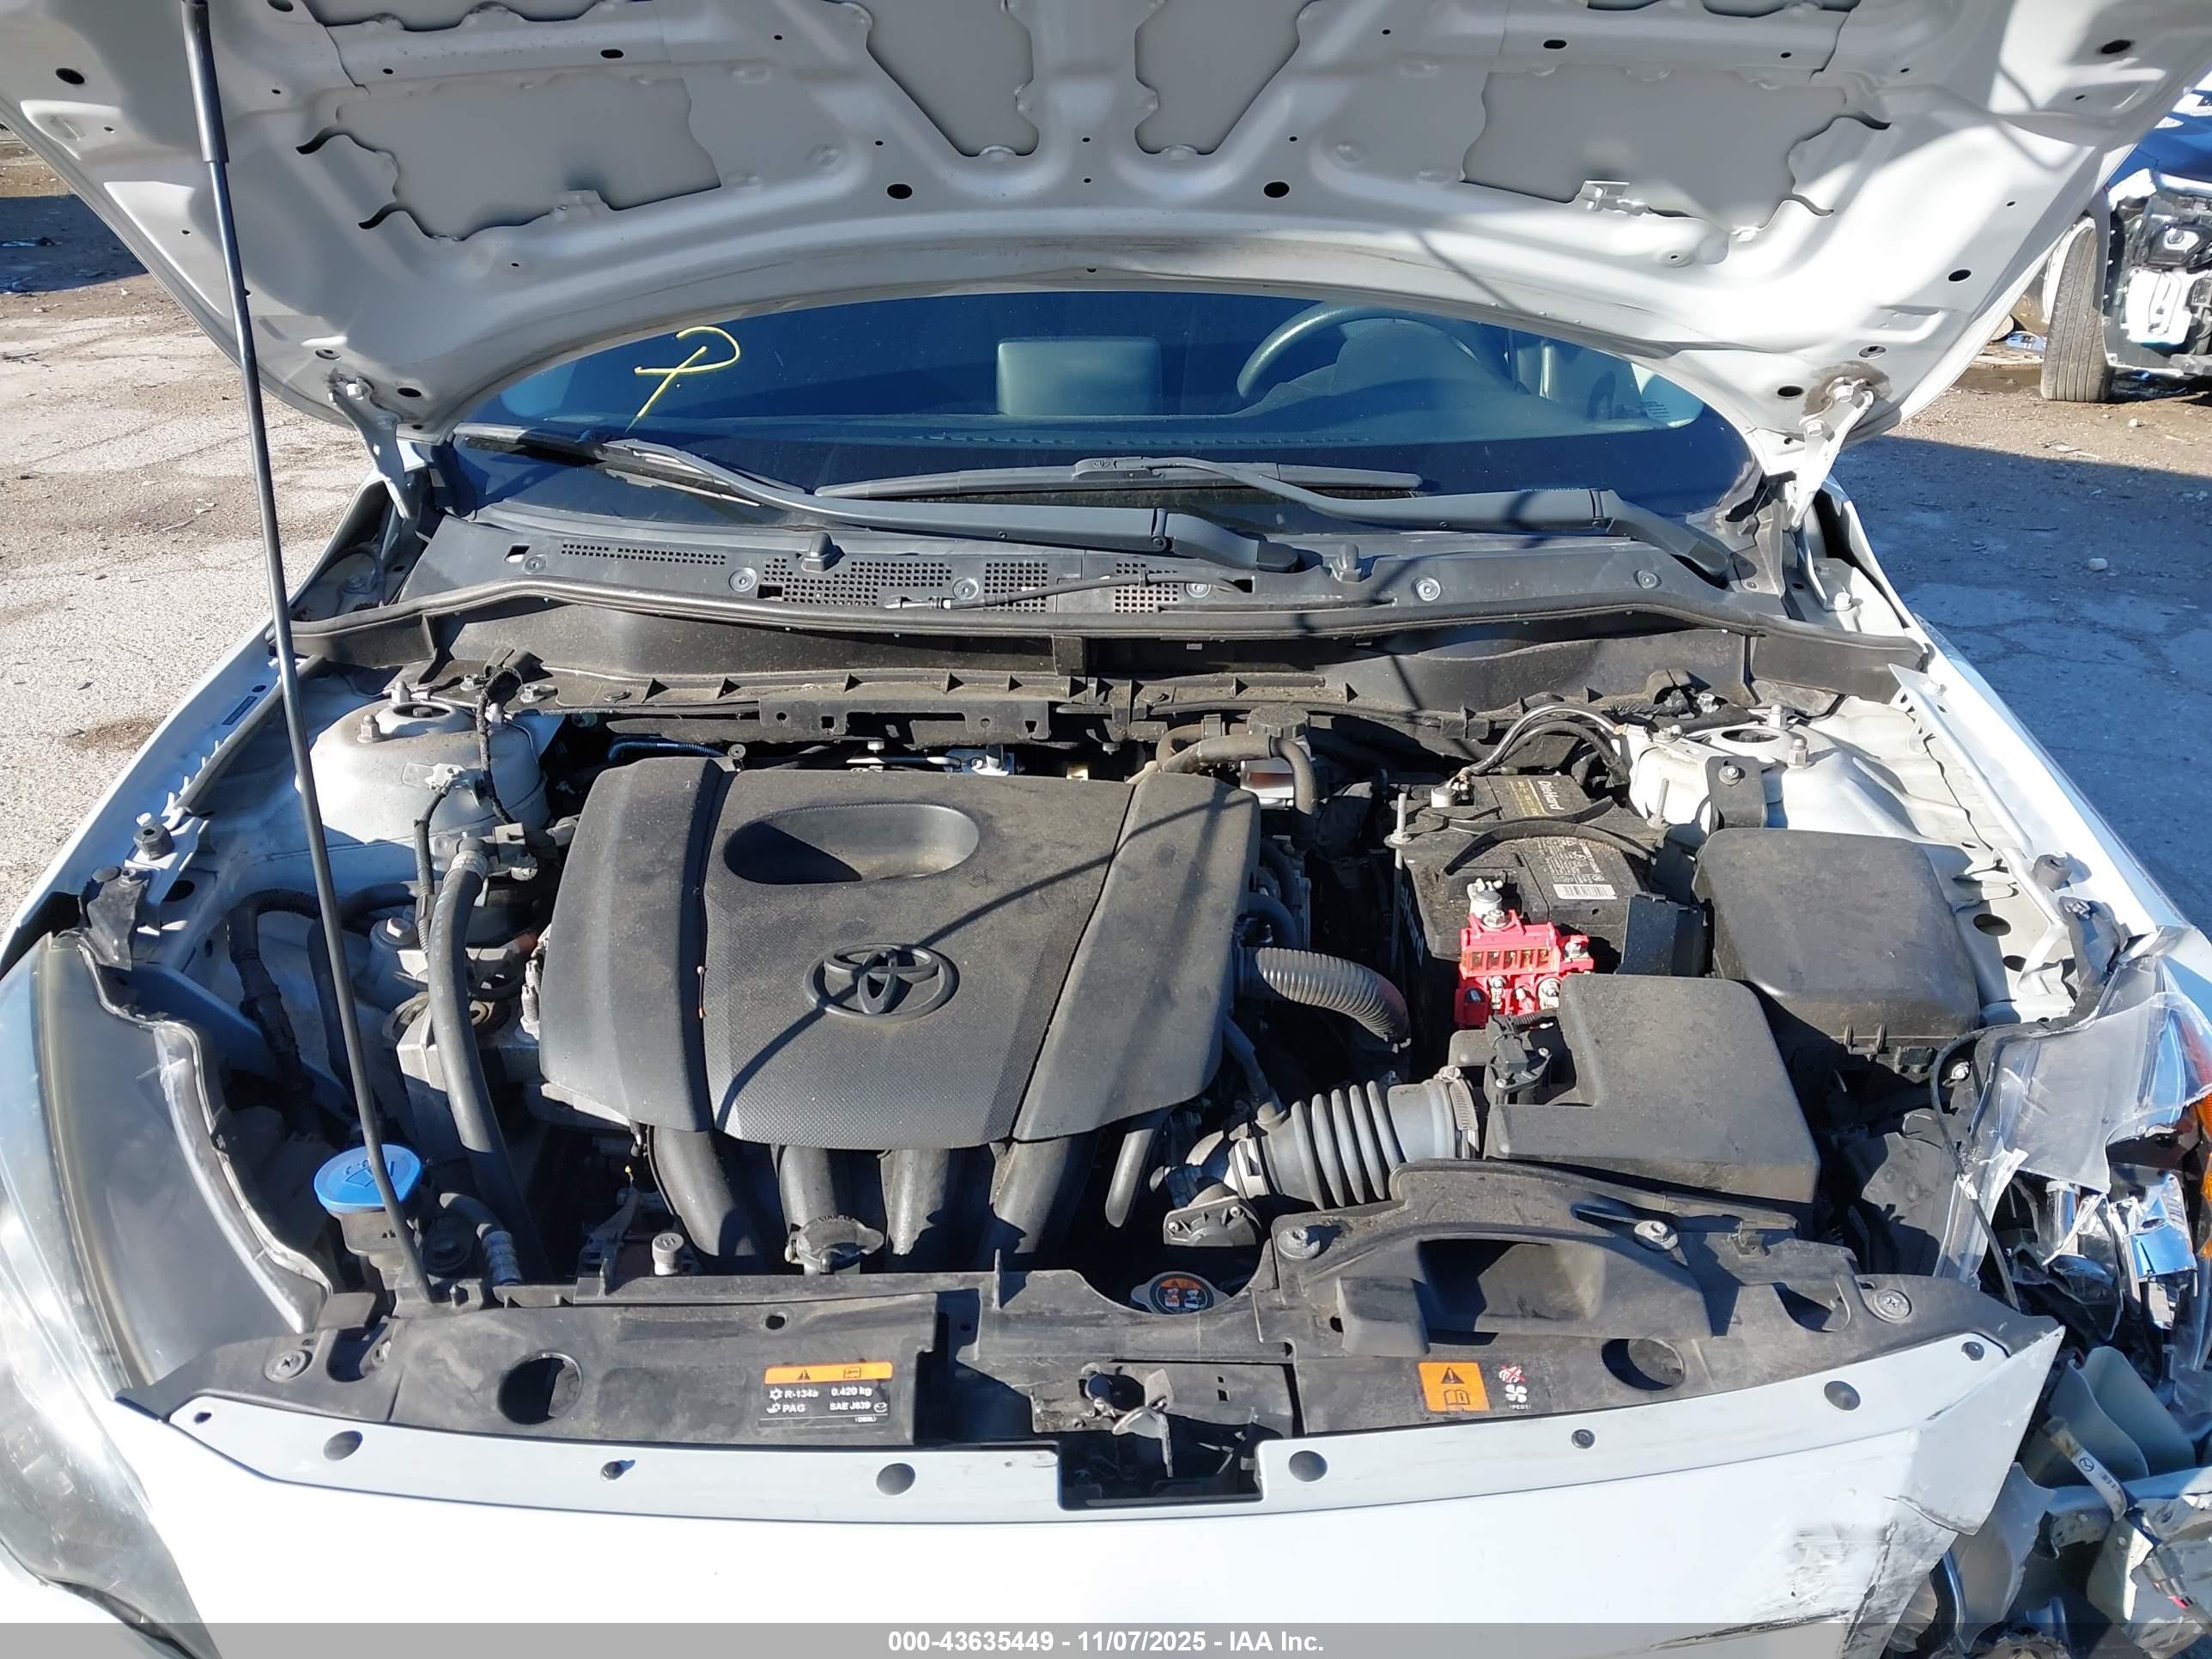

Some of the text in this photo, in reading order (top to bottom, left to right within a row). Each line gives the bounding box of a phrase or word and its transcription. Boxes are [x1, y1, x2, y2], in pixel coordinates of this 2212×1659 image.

[1537, 780, 1565, 811] DieHard
[784, 1386, 872, 1399] R-134a 0.420 kg
[782, 1403, 806, 1413] PAG
[830, 1401, 849, 1411] SAE
